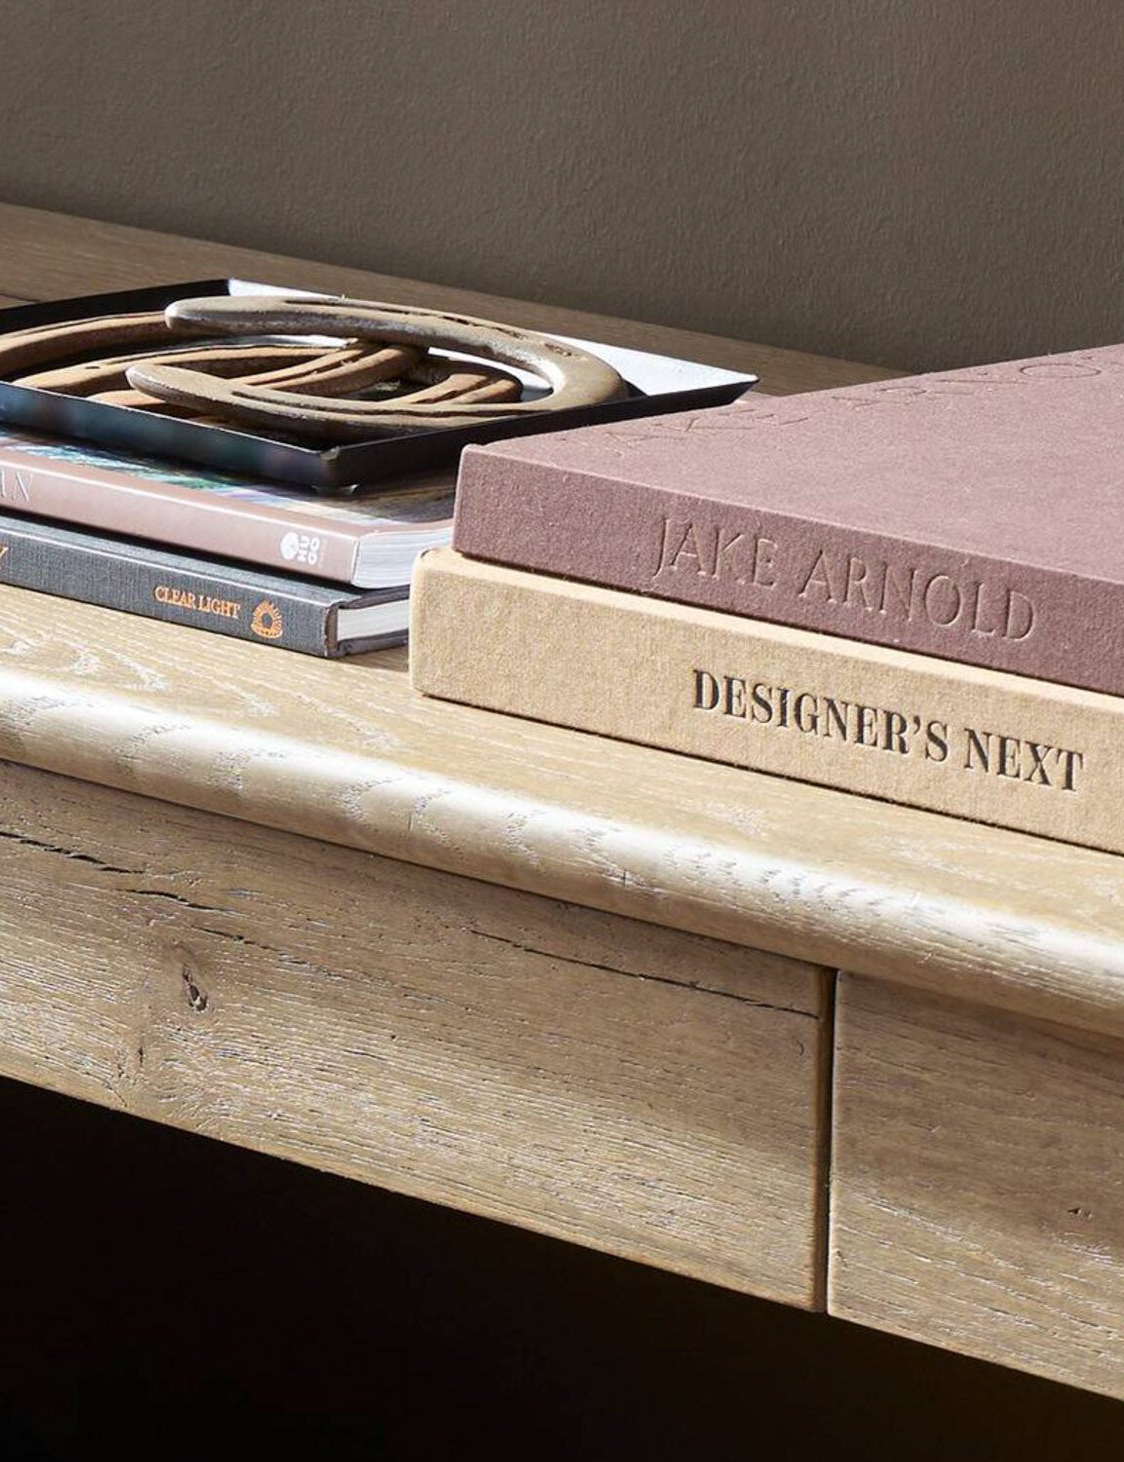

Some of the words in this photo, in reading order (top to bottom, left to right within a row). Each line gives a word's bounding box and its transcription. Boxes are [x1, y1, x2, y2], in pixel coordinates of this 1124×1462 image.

[154, 585, 196, 610] CLEAR
[197, 594, 242, 620] LIGHT
[651, 517, 778, 589] JAKE
[798, 549, 1036, 641] ARNOLD
[963, 727, 1084, 792] NEXT
